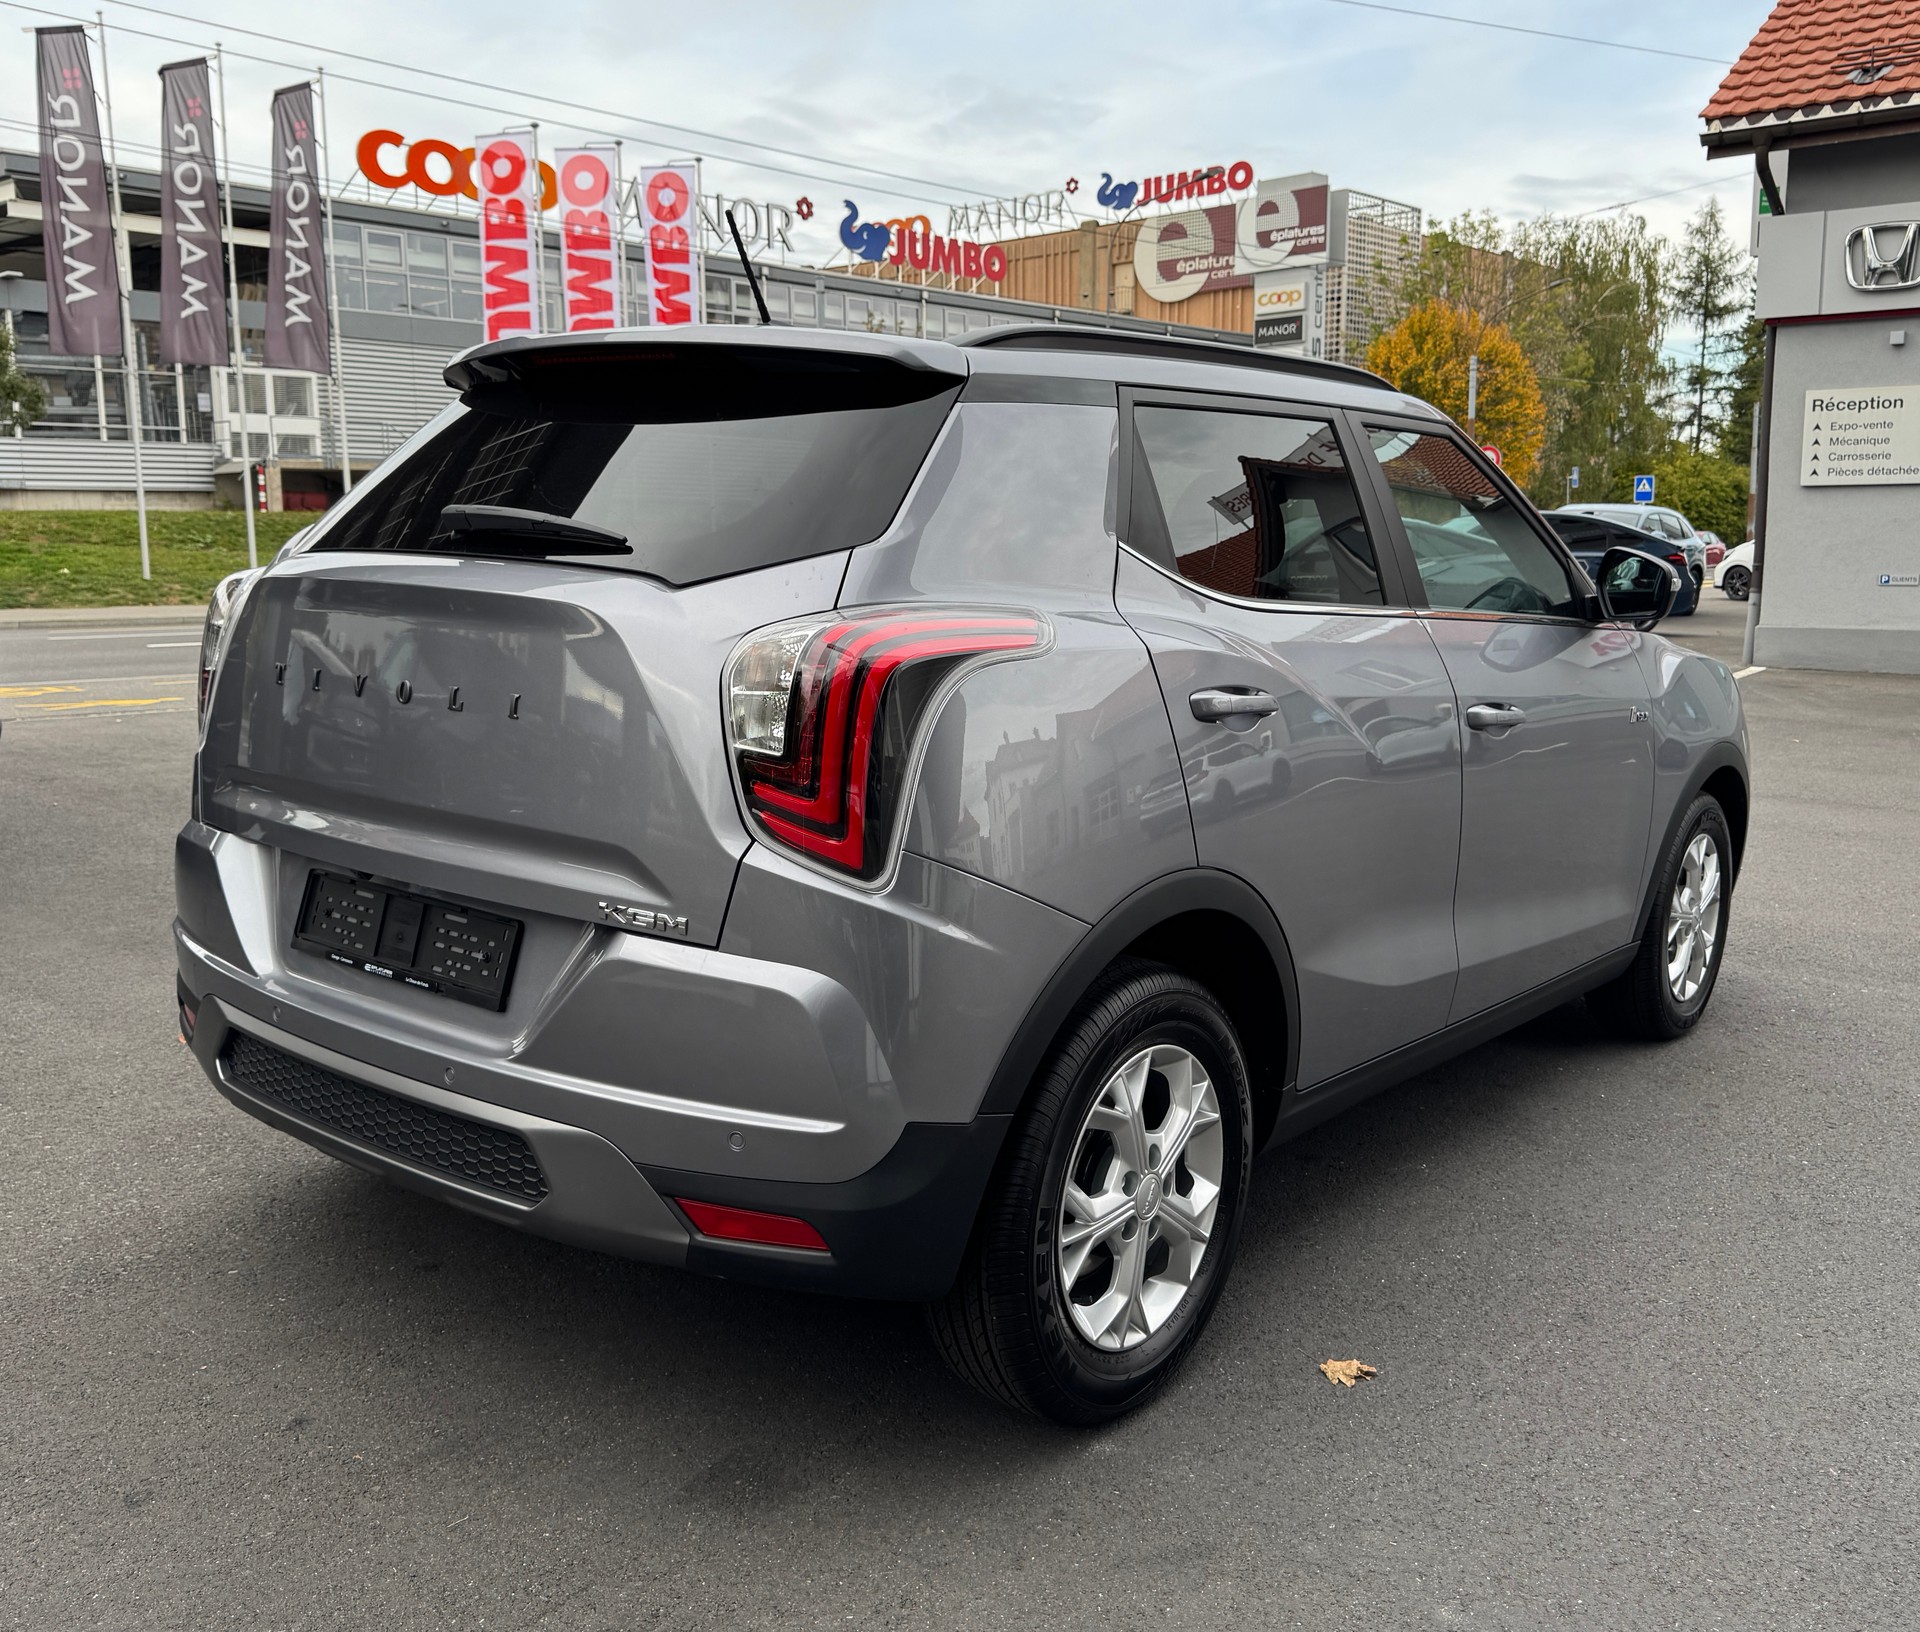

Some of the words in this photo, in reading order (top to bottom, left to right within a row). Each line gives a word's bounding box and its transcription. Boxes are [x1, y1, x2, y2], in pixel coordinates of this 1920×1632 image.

[1136, 161, 1254, 205] JUMBO
[948, 190, 1065, 236] MANOR
[1270, 225, 1326, 243] éplatures
[1296, 235, 1325, 247] centre
[889, 228, 1007, 282] JUMBO
[1176, 255, 1235, 274] éplatur
[1257, 289, 1302, 307] coop
[1258, 323, 1297, 337] MANOR
[1812, 396, 1904, 413] Réception
[1830, 420, 1894, 432] Expo-vente
[1829, 436, 1891, 447] Mécanique
[1828, 451, 1892, 461] Carrosserie
[1827, 467, 1864, 477] Pièces
[275, 662, 521, 720] TIVOLI
[598, 901, 688, 936] KGM
[1034, 1207, 1078, 1379] NEXEN
